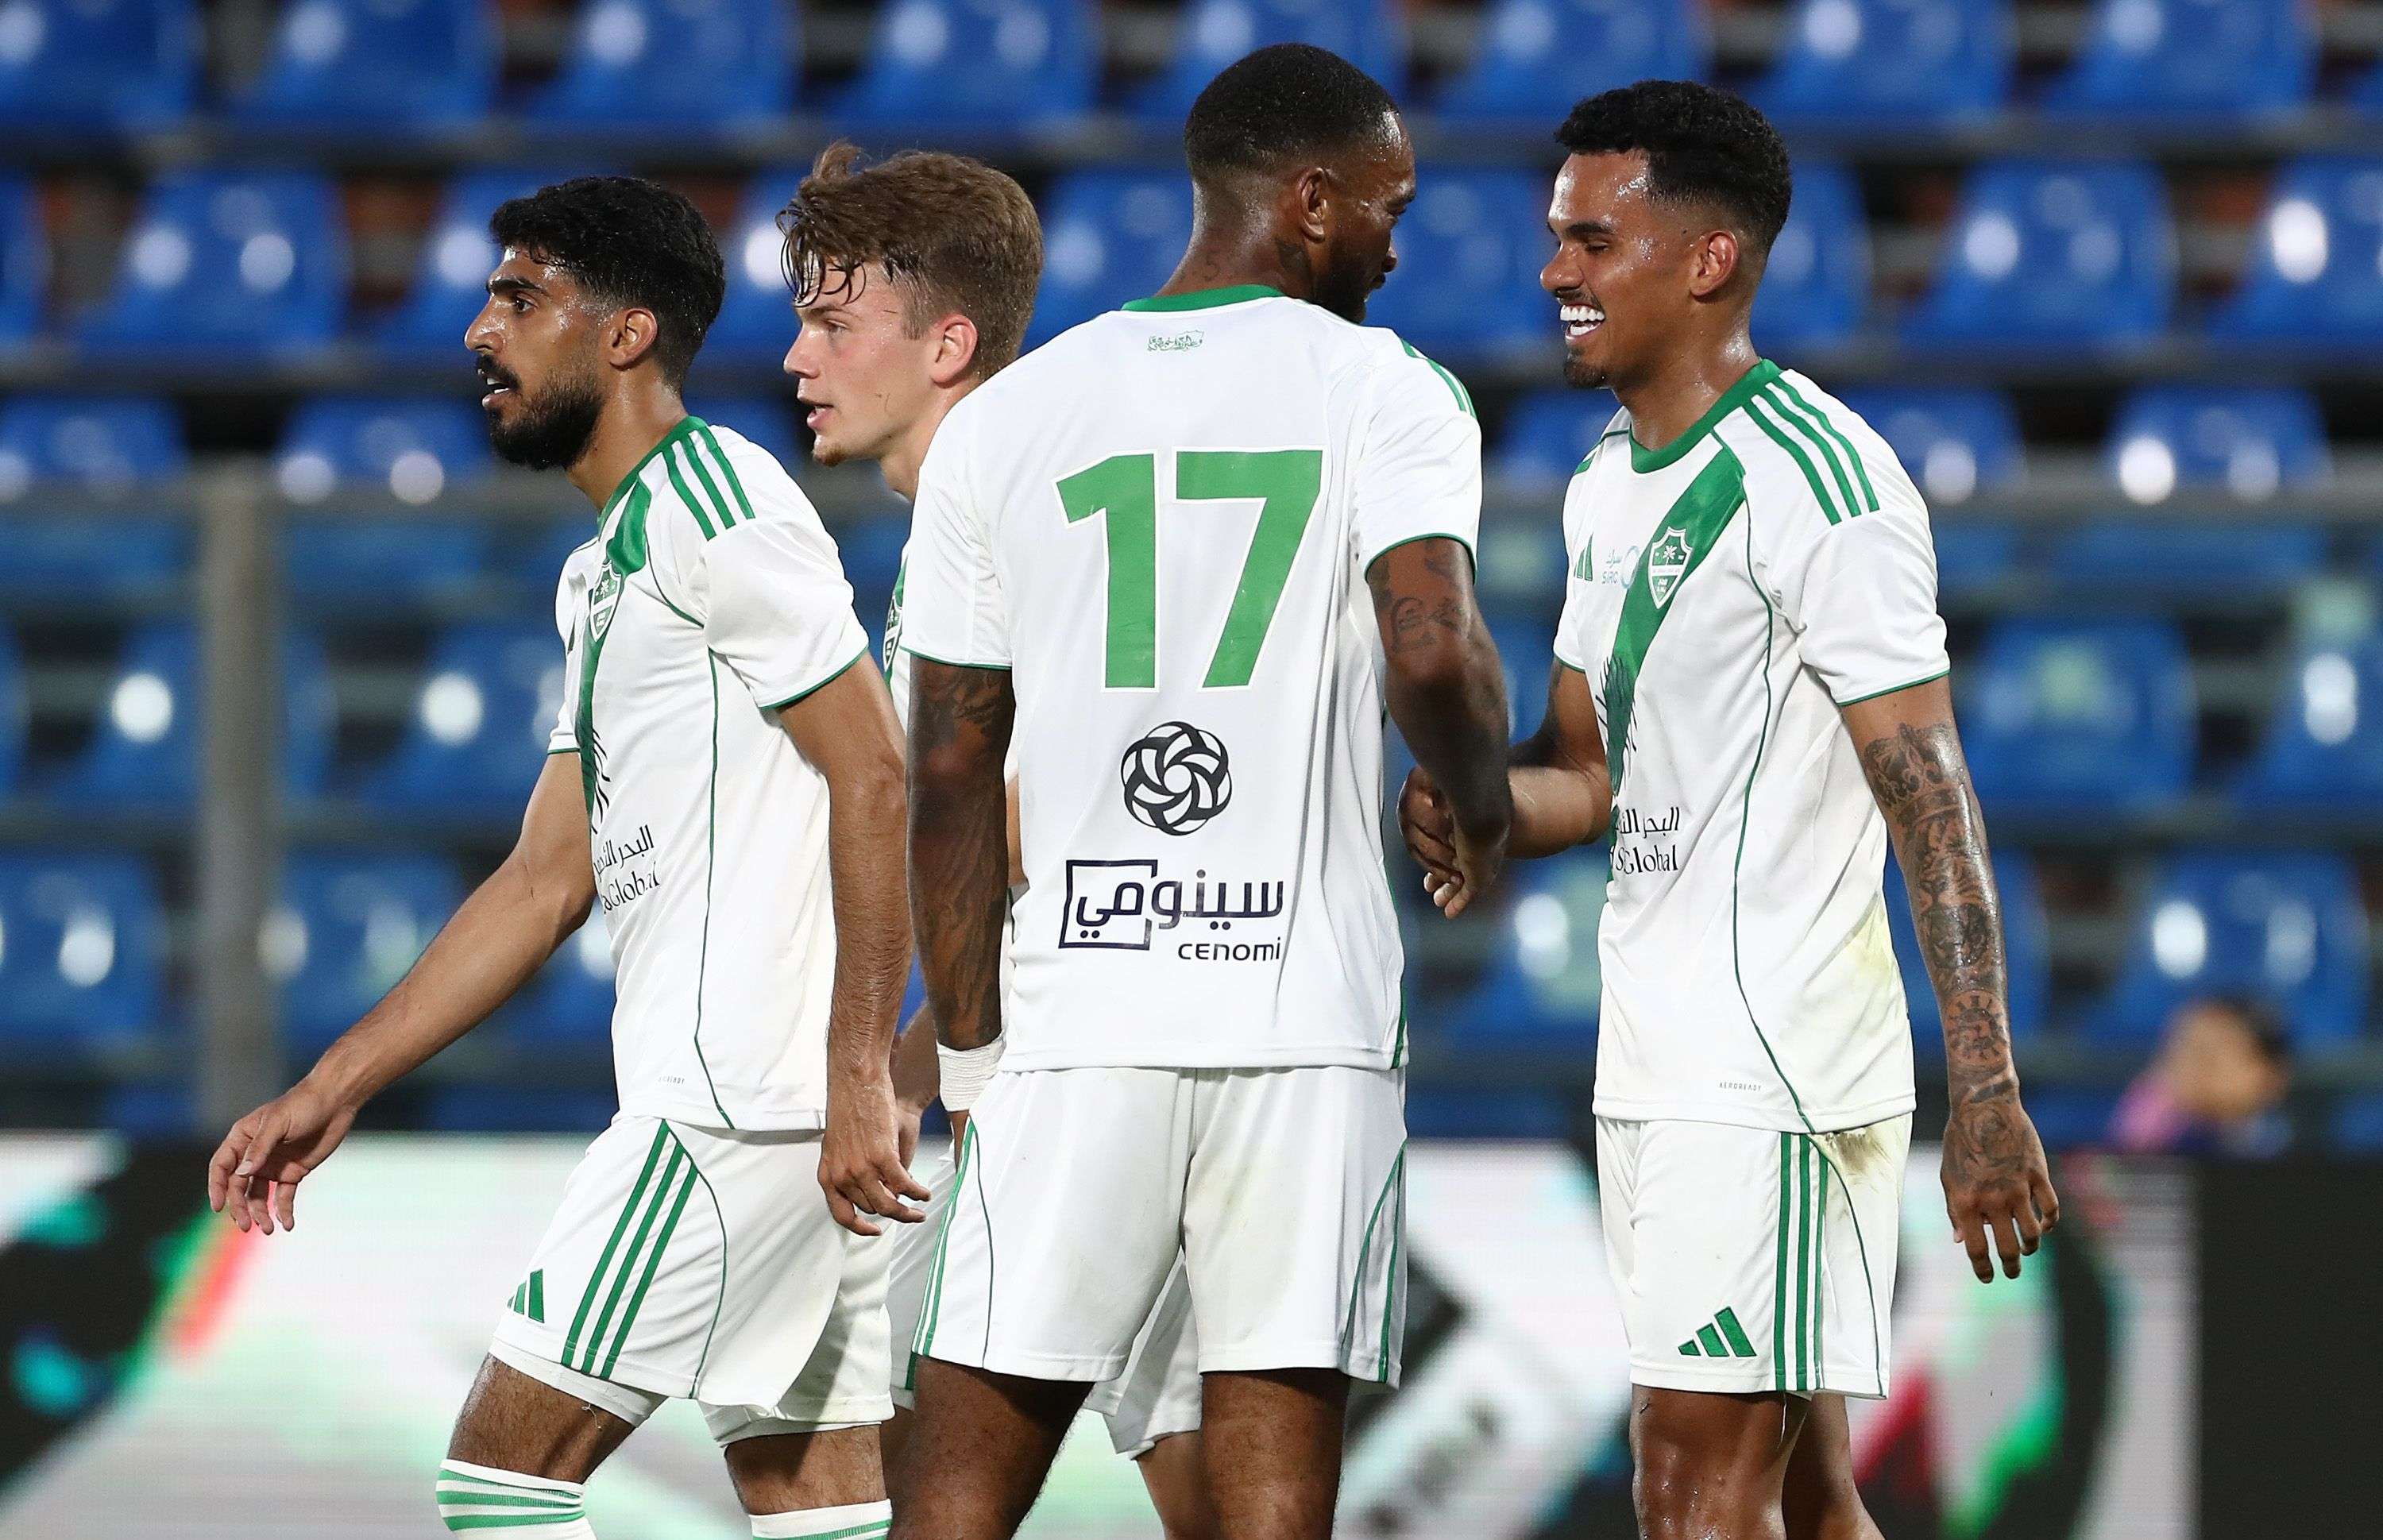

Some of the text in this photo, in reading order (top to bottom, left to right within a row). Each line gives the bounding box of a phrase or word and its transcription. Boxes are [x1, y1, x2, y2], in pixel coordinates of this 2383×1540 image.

[1056, 448, 1324, 689] 17
[618, 824, 654, 869] البحر
[1076, 869, 1284, 938] سينومي
